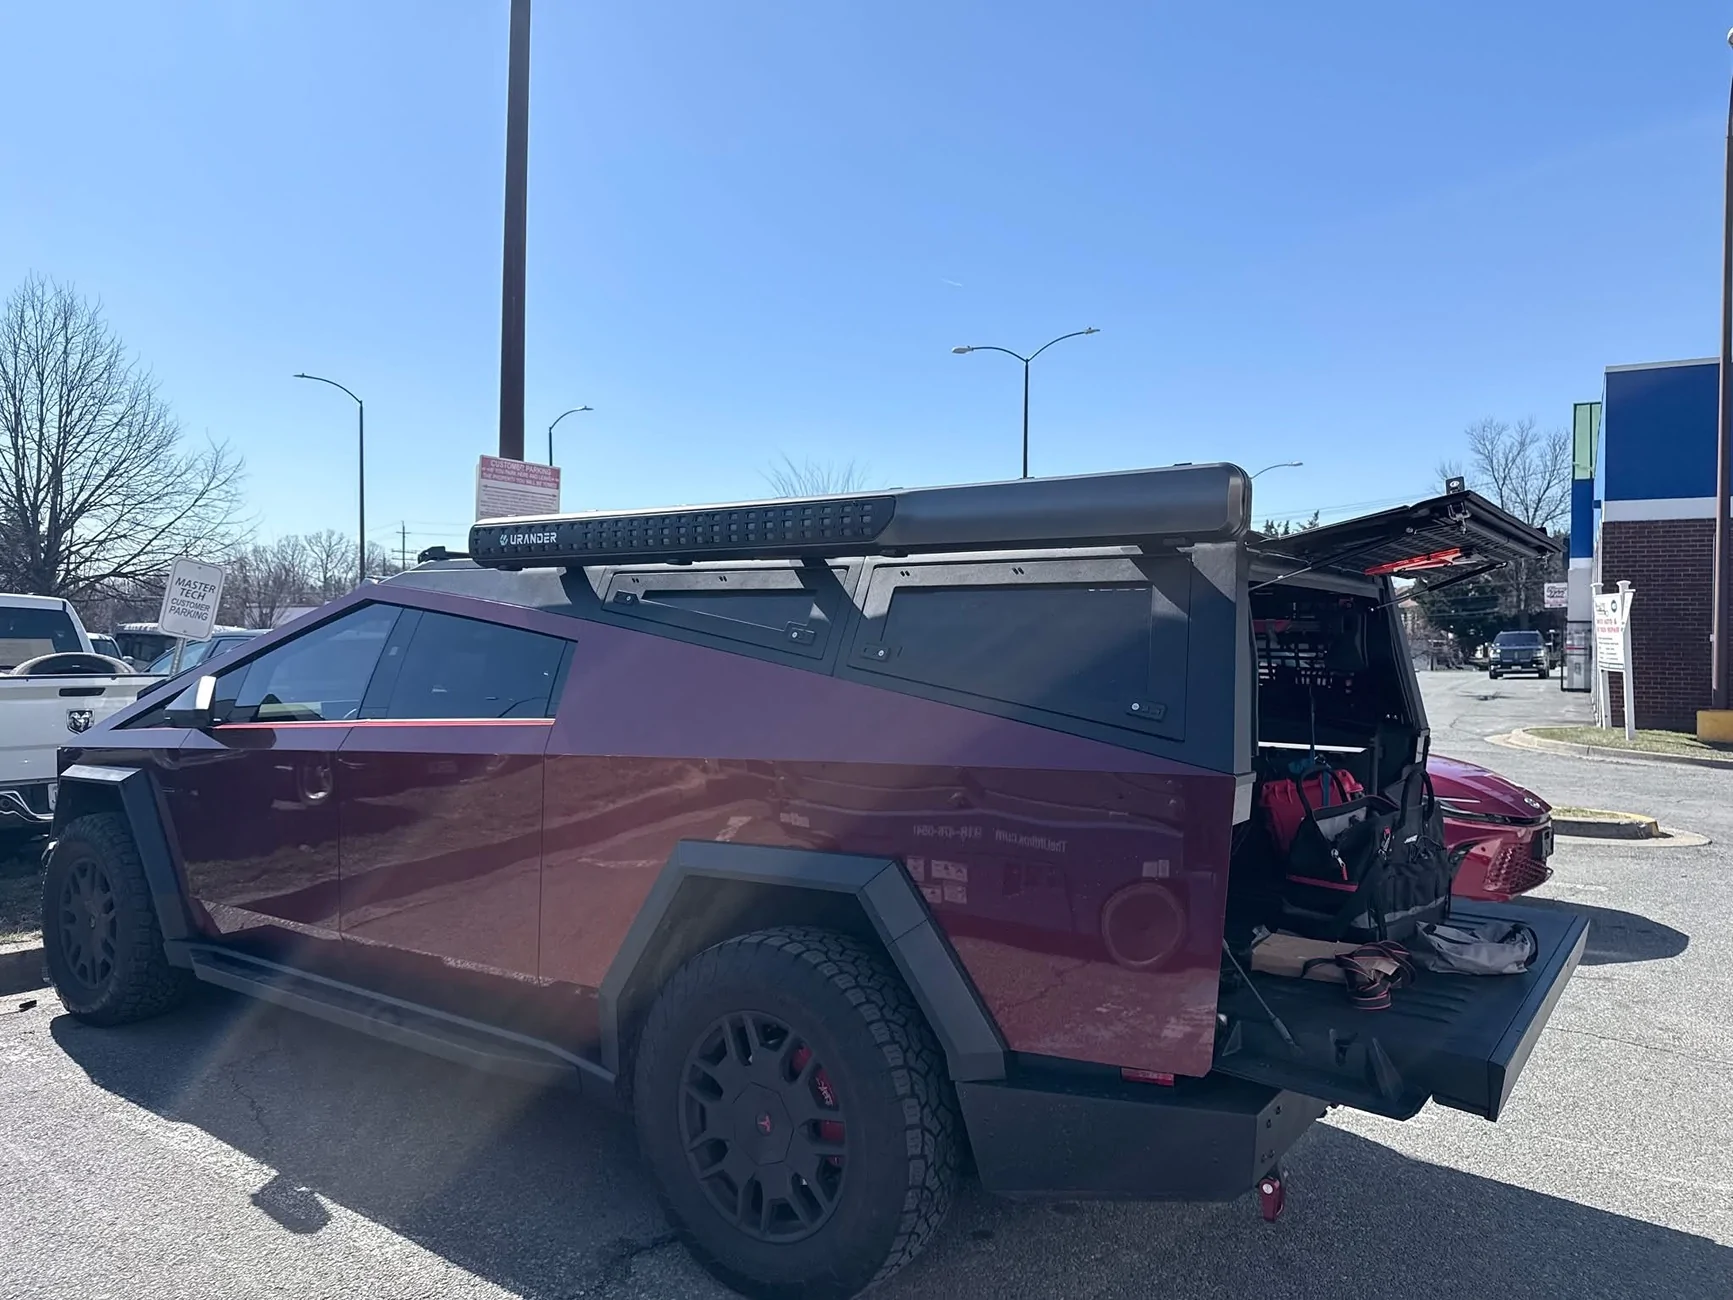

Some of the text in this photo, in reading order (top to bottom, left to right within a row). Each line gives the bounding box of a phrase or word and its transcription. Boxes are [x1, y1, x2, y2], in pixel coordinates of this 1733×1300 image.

[490, 459, 551, 475] CUSTOMER PARKING
[510, 532, 557, 545] URANDER
[175, 577, 216, 593] MASTER
[180, 588, 207, 601] TECH
[171, 597, 210, 612] CUSTOMER
[169, 606, 208, 621] PARKING
